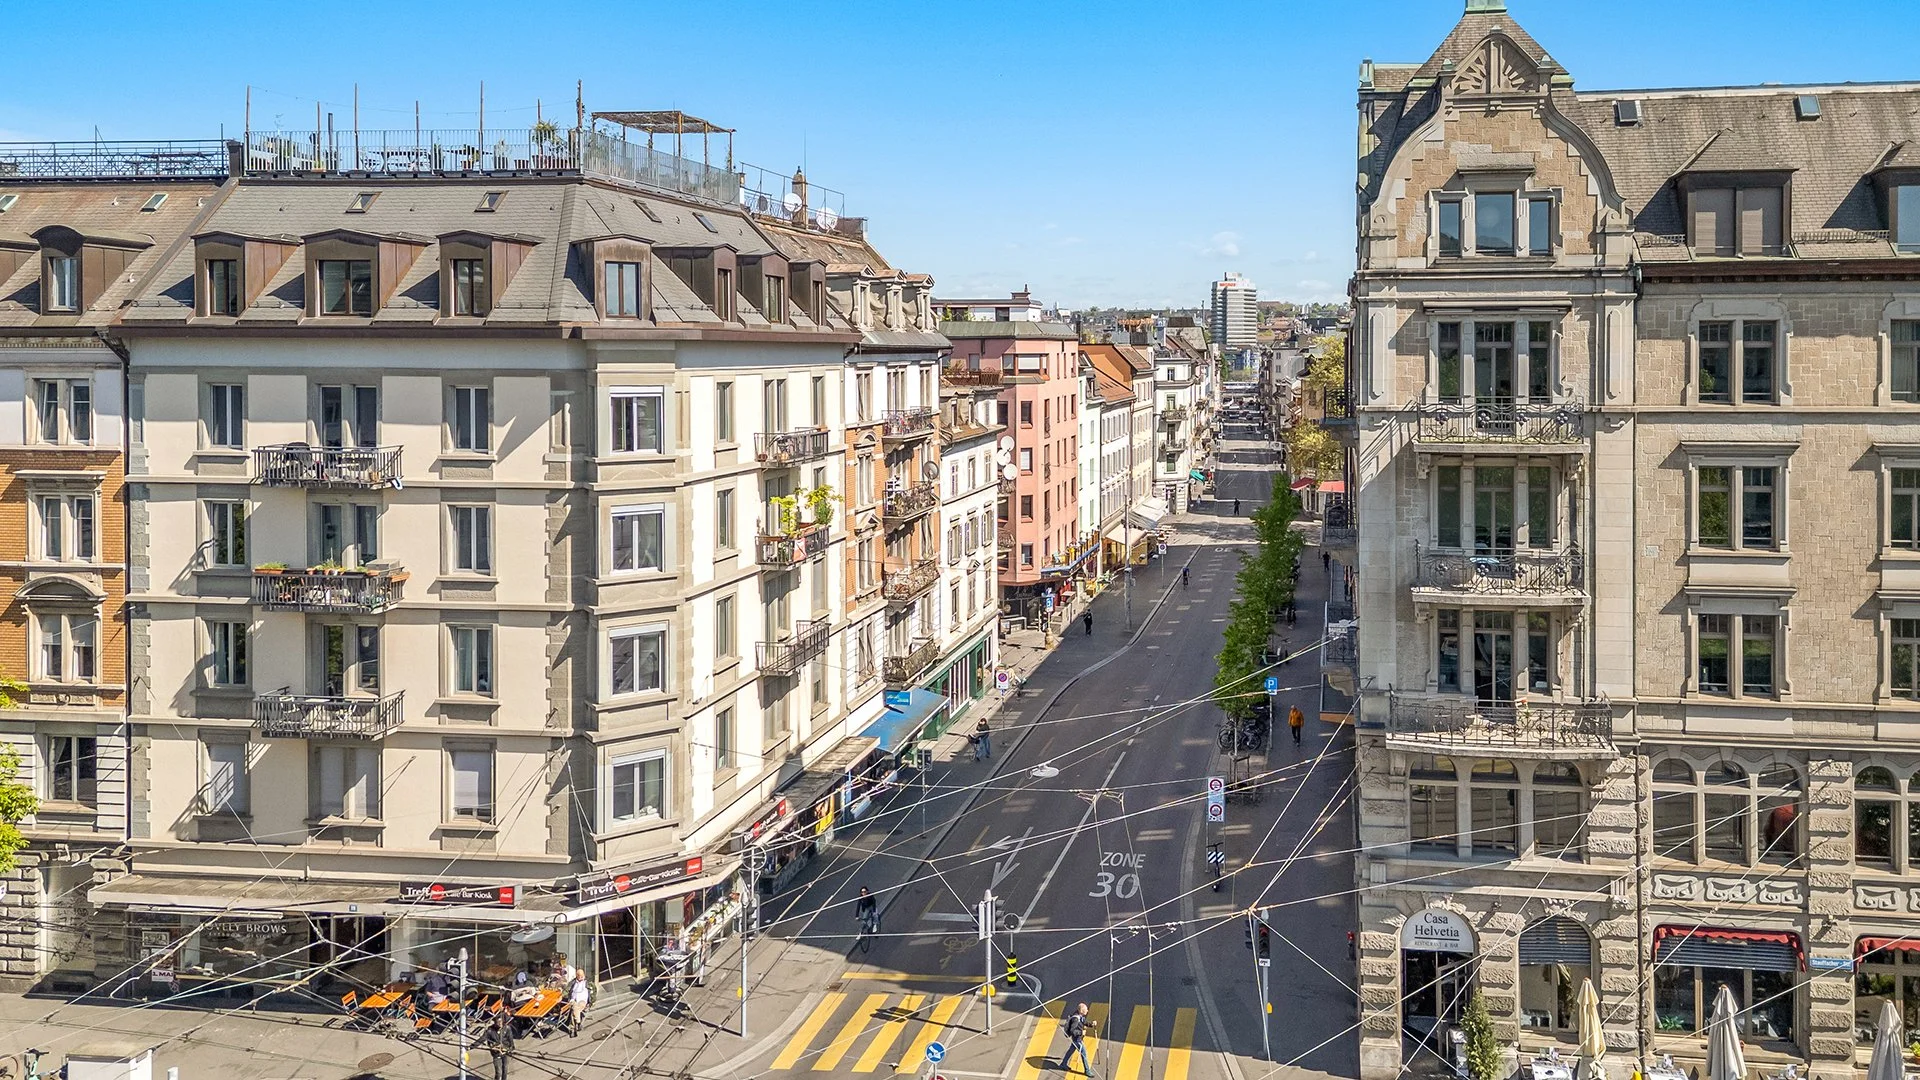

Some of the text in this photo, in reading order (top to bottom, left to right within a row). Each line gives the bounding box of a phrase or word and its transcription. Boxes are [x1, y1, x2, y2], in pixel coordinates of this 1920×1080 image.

[1100, 852, 1146, 868] ZONE
[1089, 872, 1140, 899] 30
[462, 890, 473, 898] Bar
[475, 891, 493, 899] Kiosk
[1424, 913, 1448, 924] Casa
[247, 923, 287, 934] BROWS
[1415, 925, 1459, 937] Helvetia
